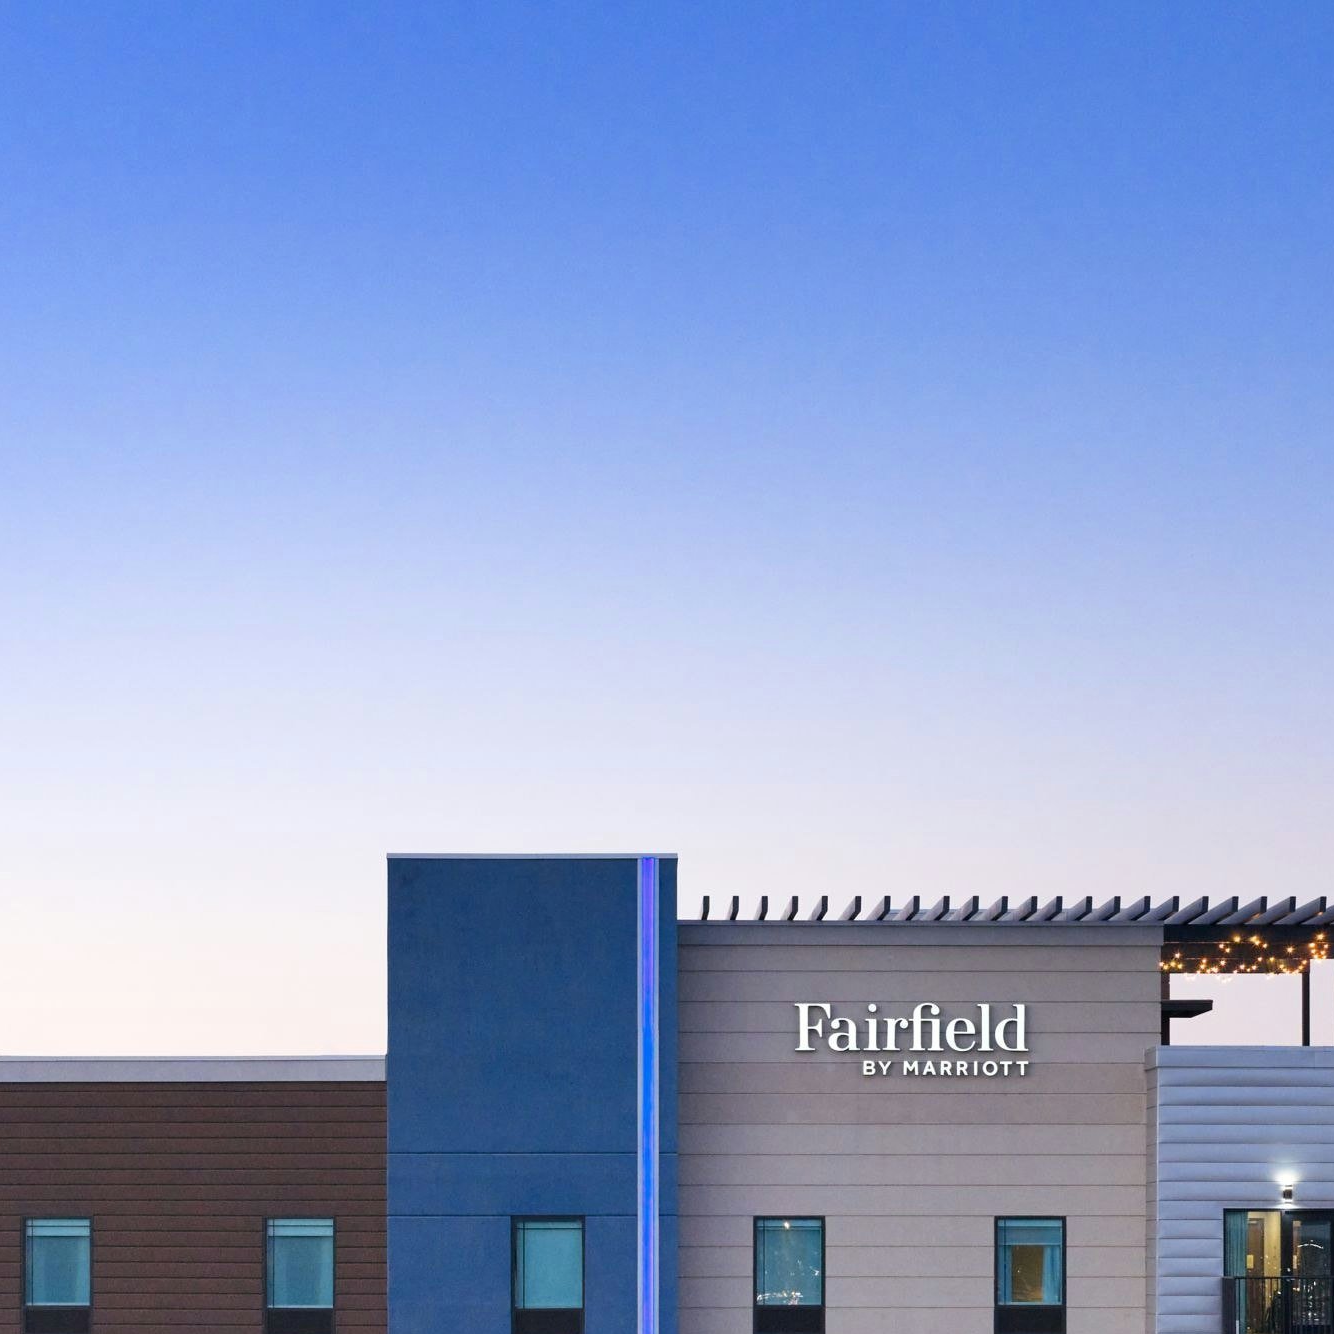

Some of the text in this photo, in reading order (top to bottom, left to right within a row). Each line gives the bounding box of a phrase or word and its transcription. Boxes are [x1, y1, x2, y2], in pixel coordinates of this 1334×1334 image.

[794, 1003, 1029, 1052] Fairfield
[863, 1060, 1029, 1076] BY MARRIOTT
